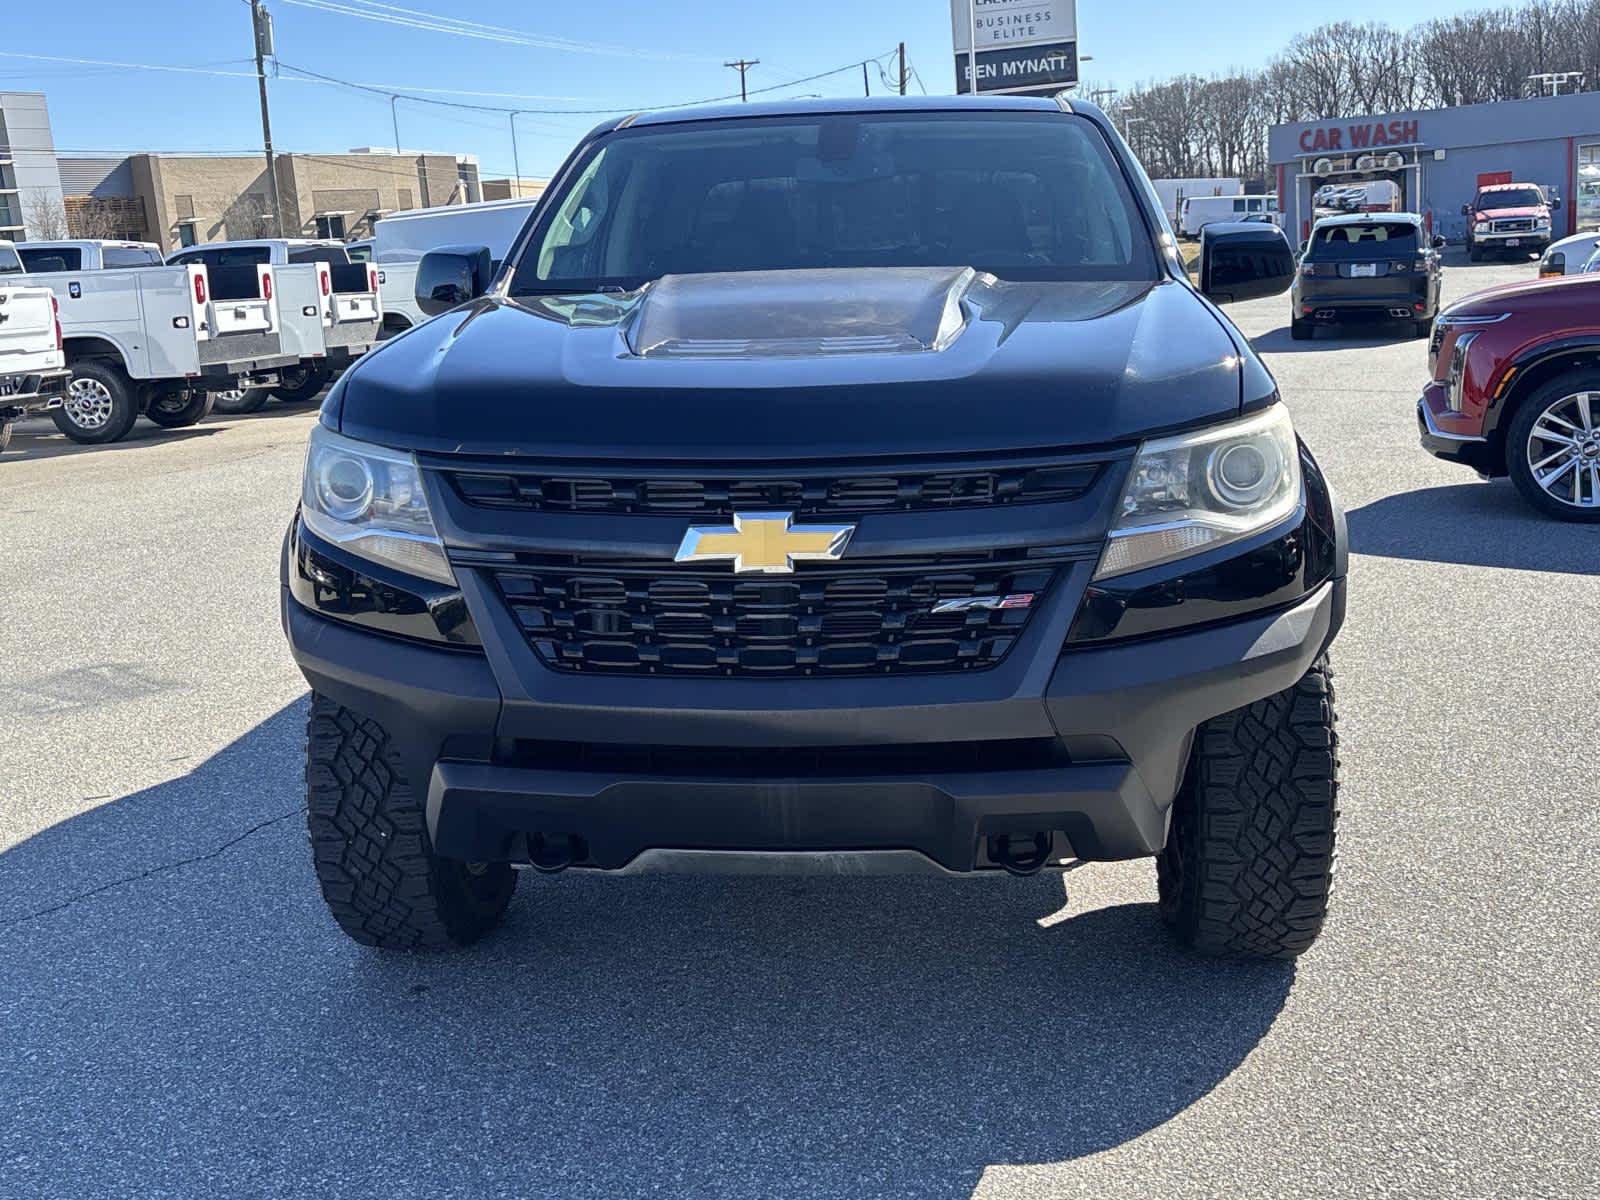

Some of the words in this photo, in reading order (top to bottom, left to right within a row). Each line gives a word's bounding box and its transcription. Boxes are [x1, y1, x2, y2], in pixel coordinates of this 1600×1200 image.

[976, 11, 1052, 28] BUSINESS
[993, 26, 1036, 40] ELITE
[1002, 55, 1067, 76] MYNATT
[1299, 127, 1342, 151] CAR
[1349, 119, 1419, 147] WASH
[930, 593, 1034, 614] ZR2
